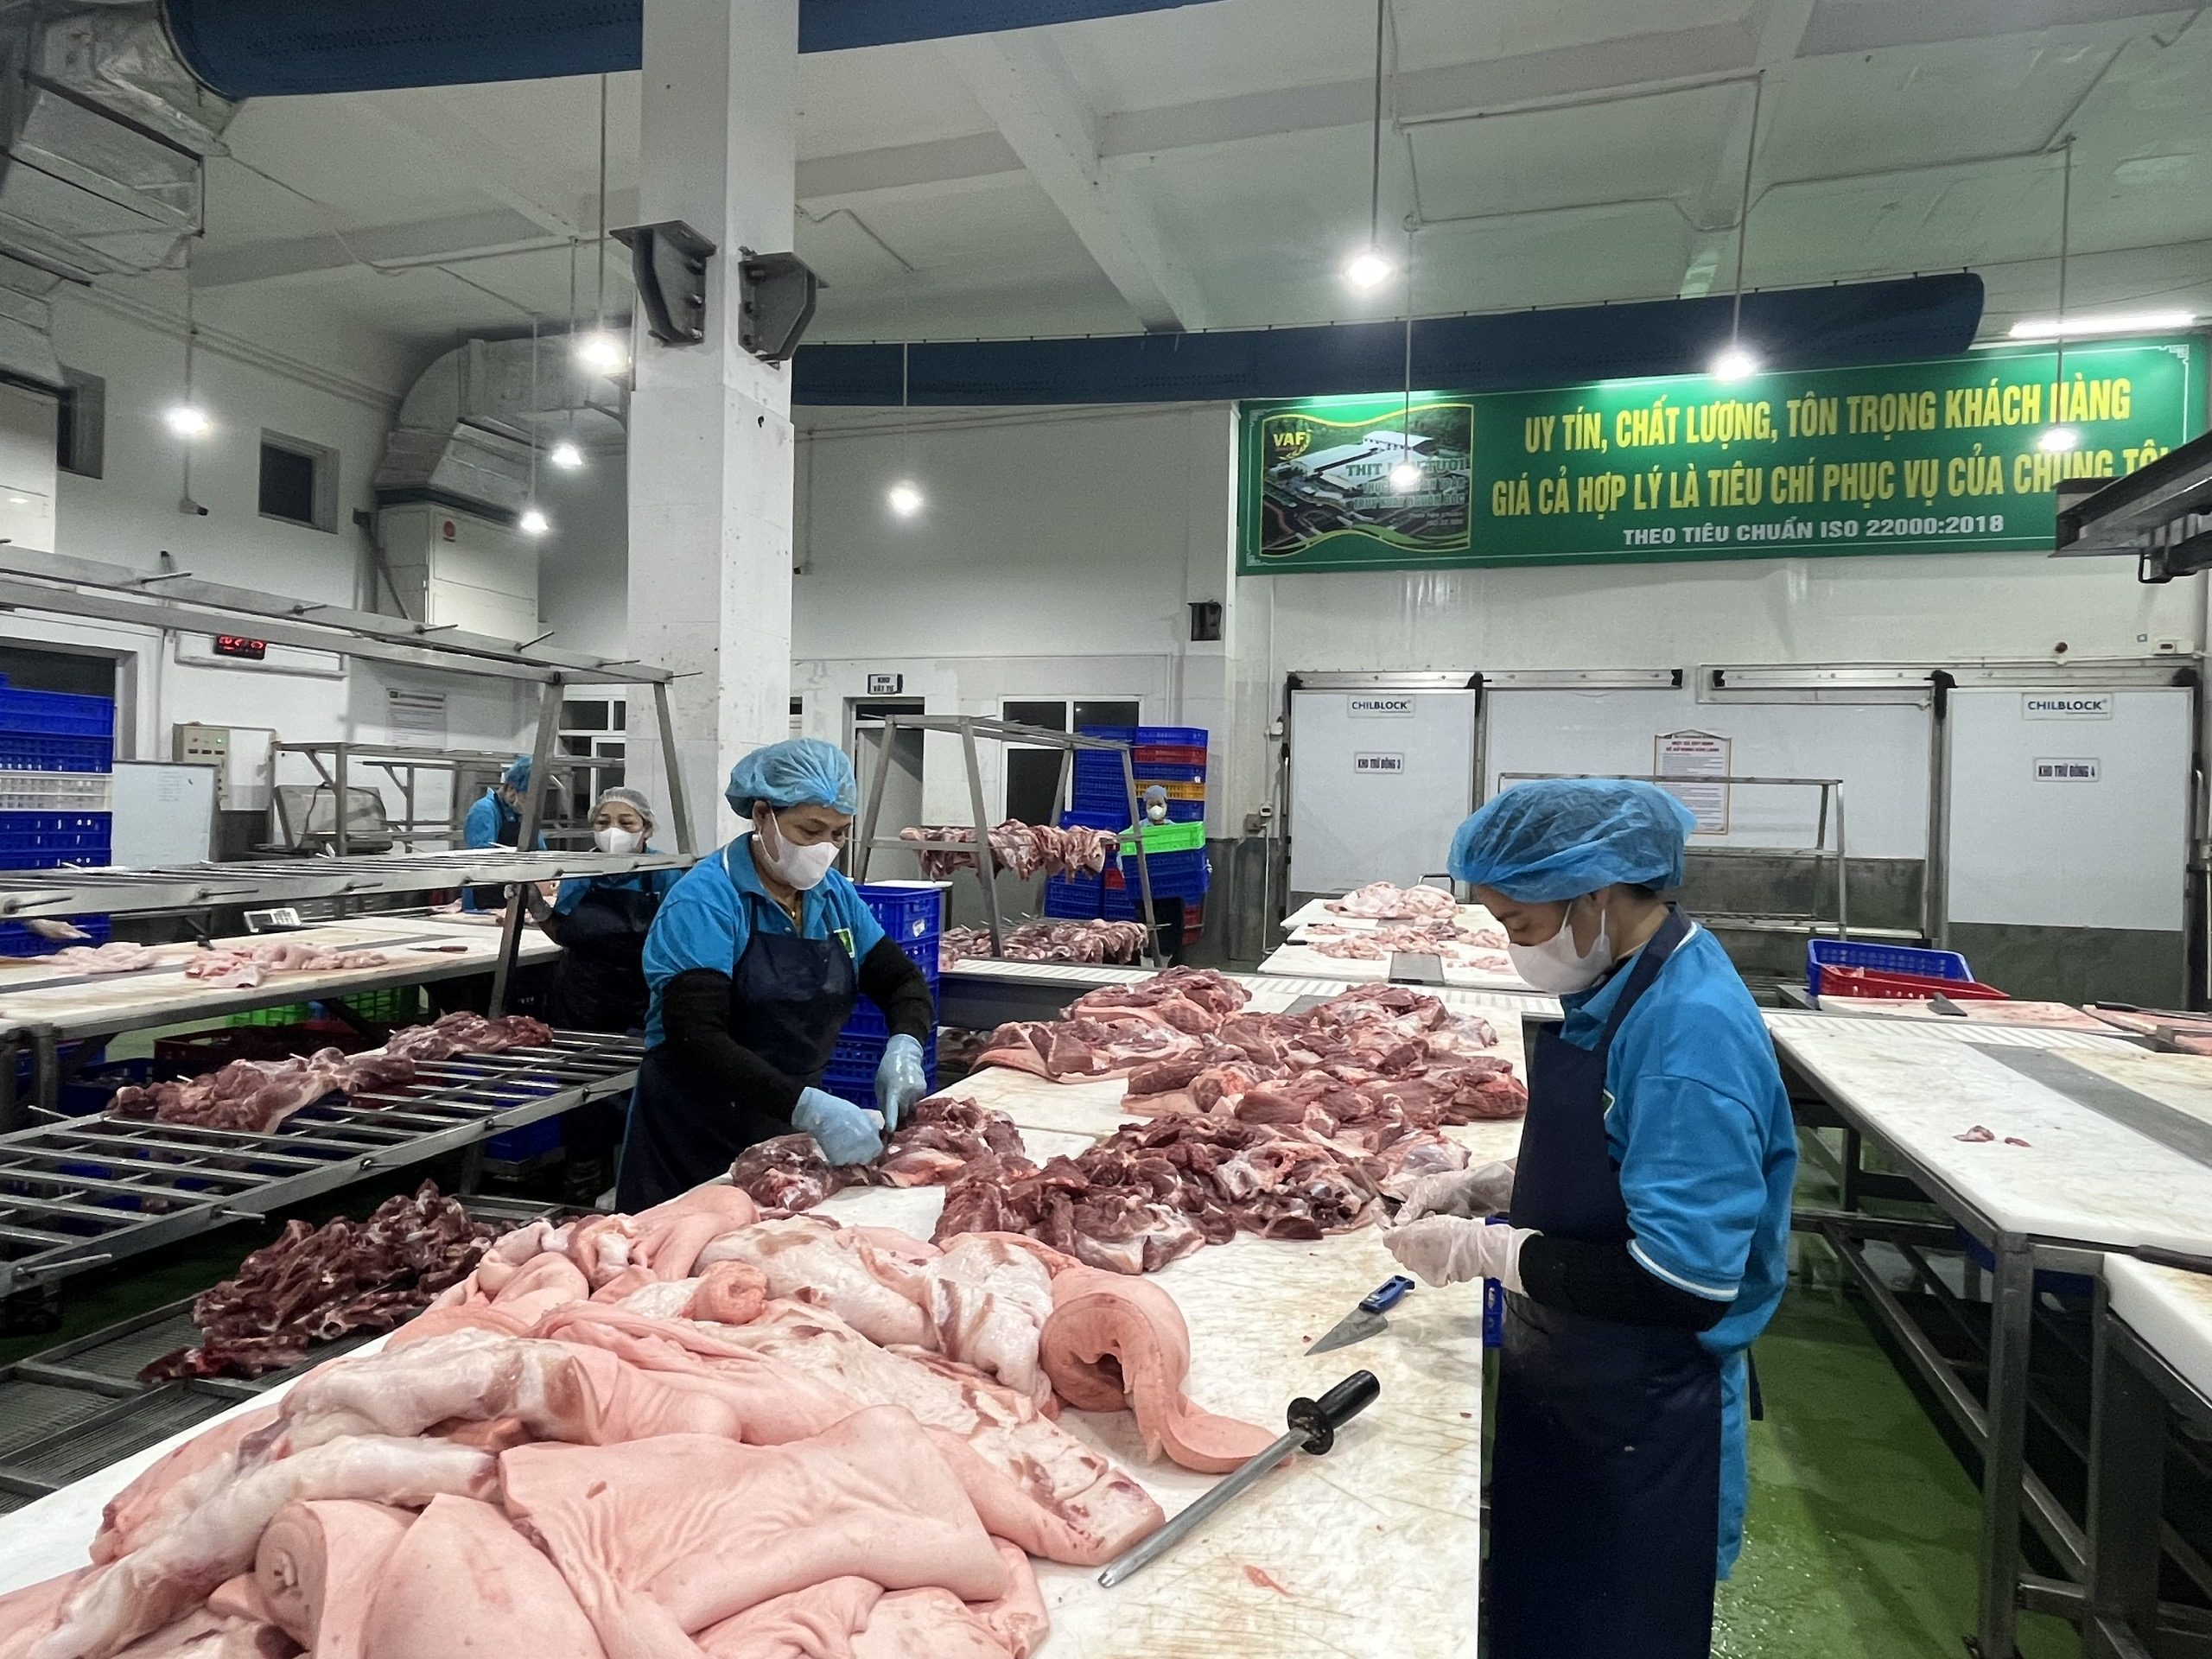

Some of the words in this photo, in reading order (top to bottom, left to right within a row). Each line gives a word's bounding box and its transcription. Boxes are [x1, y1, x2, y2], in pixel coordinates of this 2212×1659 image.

[1525, 415, 1555, 454] UY
[1562, 406, 1608, 454] TÍN,
[1616, 394, 1681, 448] CHẤT
[1686, 401, 1778, 449] LƯỢNG,
[1786, 391, 1839, 437] TÔN
[1846, 391, 1936, 442] TRỌNG
[1945, 378, 2042, 429] KHÁCH
[1273, 431, 1306, 447] VAF
[1492, 472, 1531, 517] GIÁ
[1538, 465, 1570, 515] CẢ
[1577, 471, 1627, 520] HỢP
[1634, 464, 1663, 511] LÝ
[1669, 462, 1700, 509] LÀ
[1707, 460, 1764, 507] TIÊU
[1770, 456, 1815, 505] CHÍ
[1822, 461, 1895, 509] PHỤC
[1904, 458, 1940, 506] VỤ
[1948, 442, 2005, 497] CỦA
[2122, 438, 2170, 476] TÔ
[1623, 527, 1676, 545] THEO
[1681, 522, 1730, 543] TIÊU
[1821, 519, 1859, 538] ISO
[1866, 514, 2004, 537] 22000:2018
[1351, 701, 1408, 710] CHILBLOCK
[2027, 701, 2103, 710] CHILBLOCK
